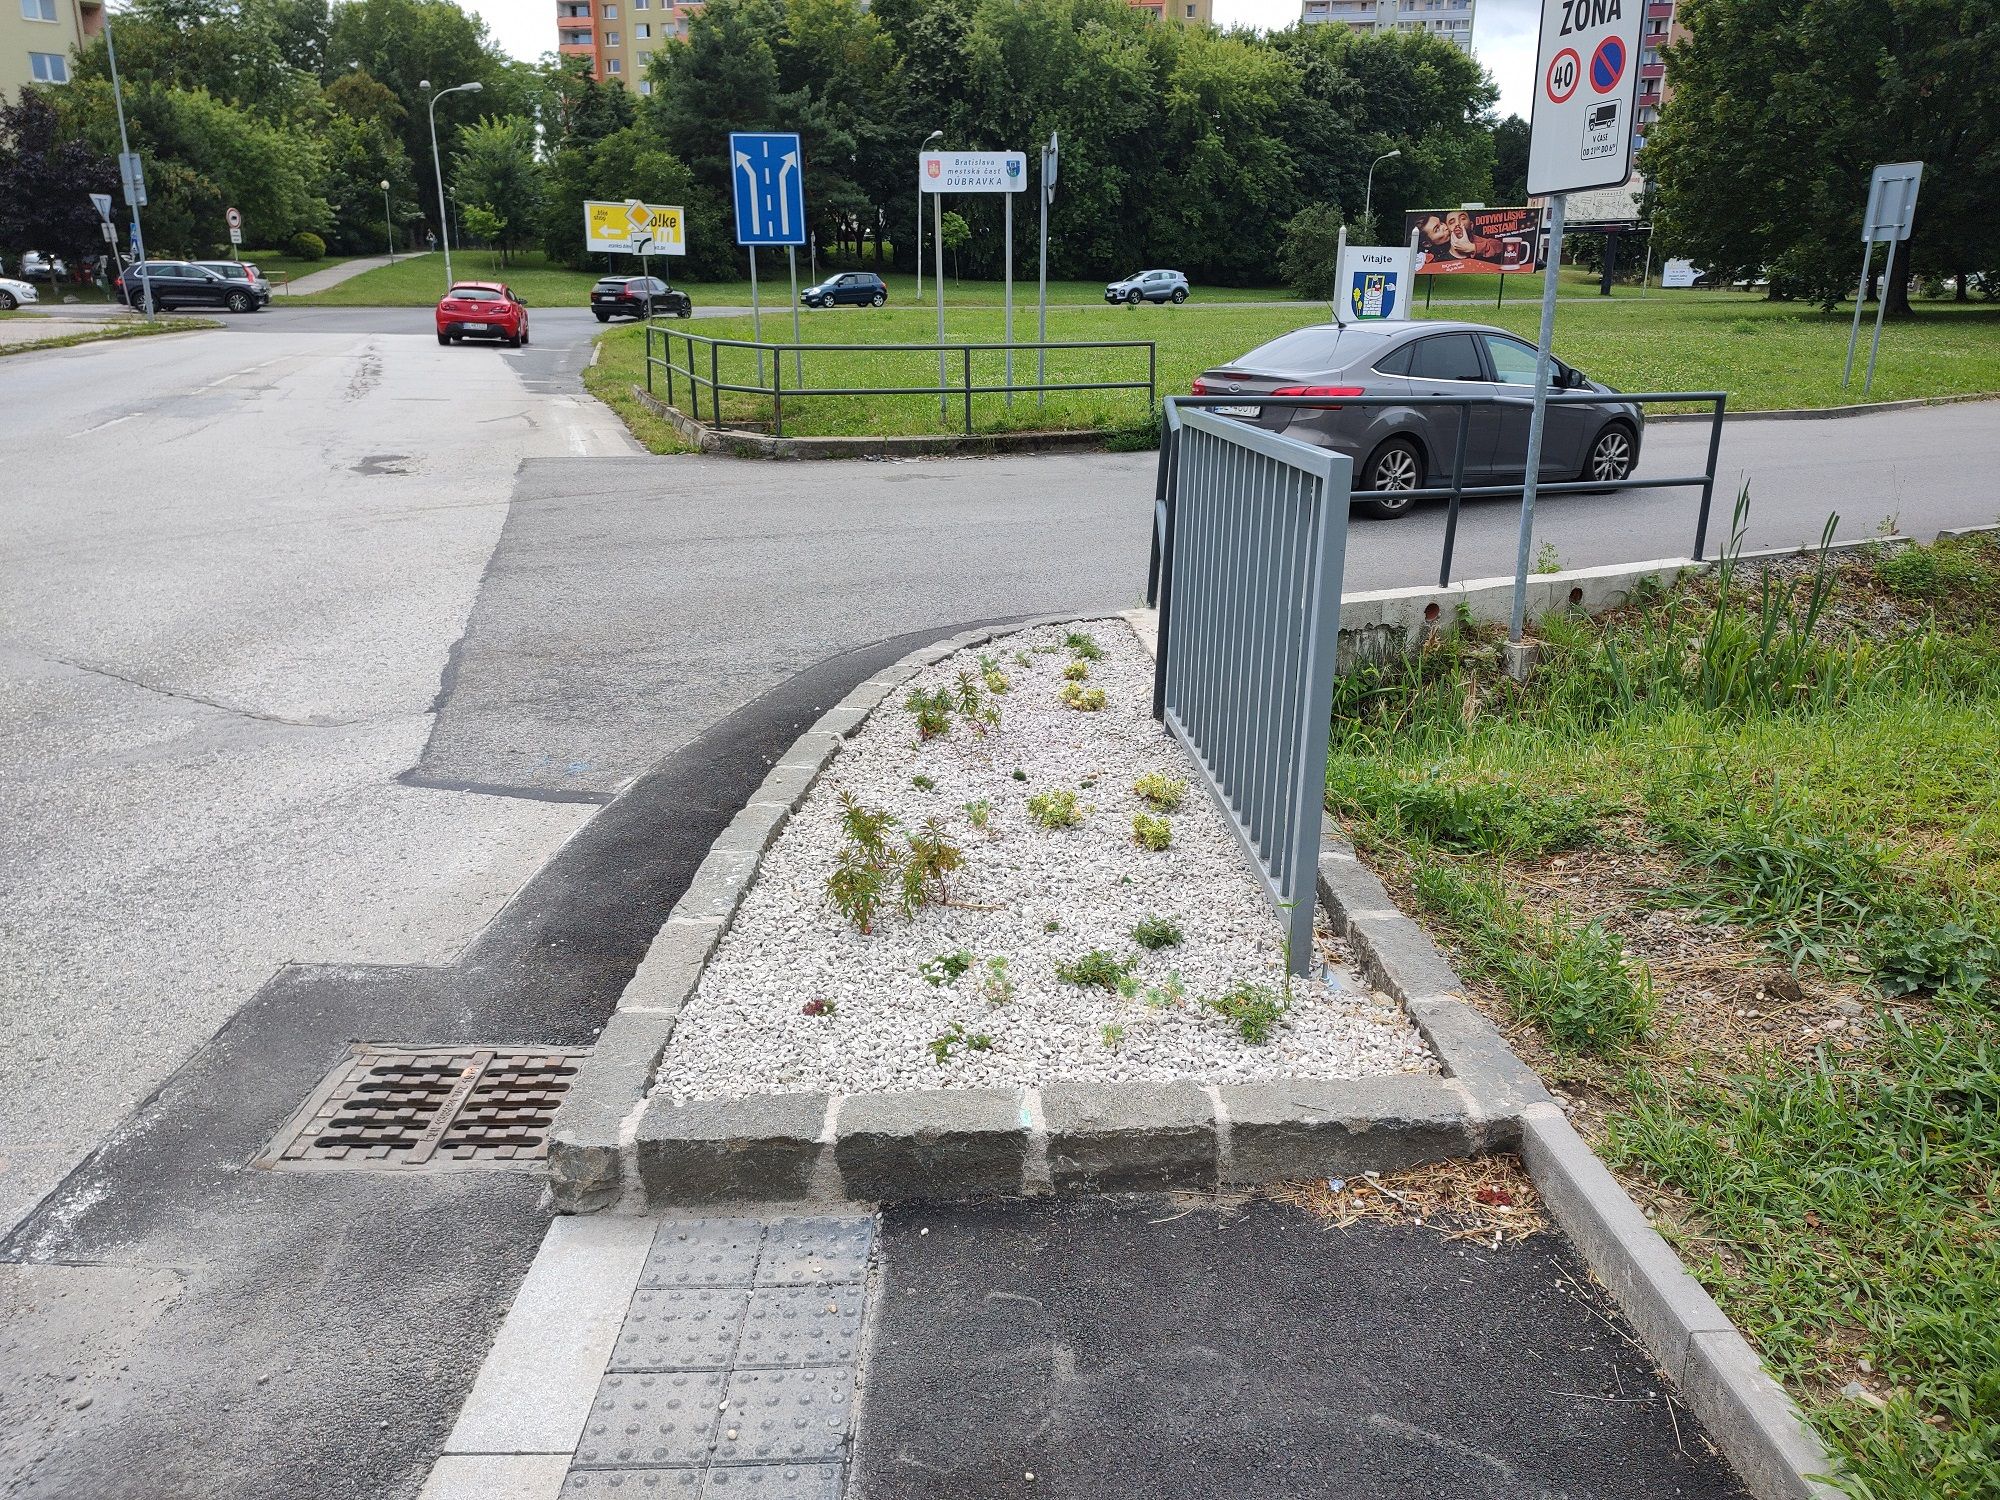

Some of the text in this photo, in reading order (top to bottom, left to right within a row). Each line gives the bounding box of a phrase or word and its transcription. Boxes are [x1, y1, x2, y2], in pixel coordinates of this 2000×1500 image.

[1554, 61, 1574, 90] 40
[947, 175, 1002, 186] DÚBRAVKA
[1362, 254, 1393, 265] Vitajte
